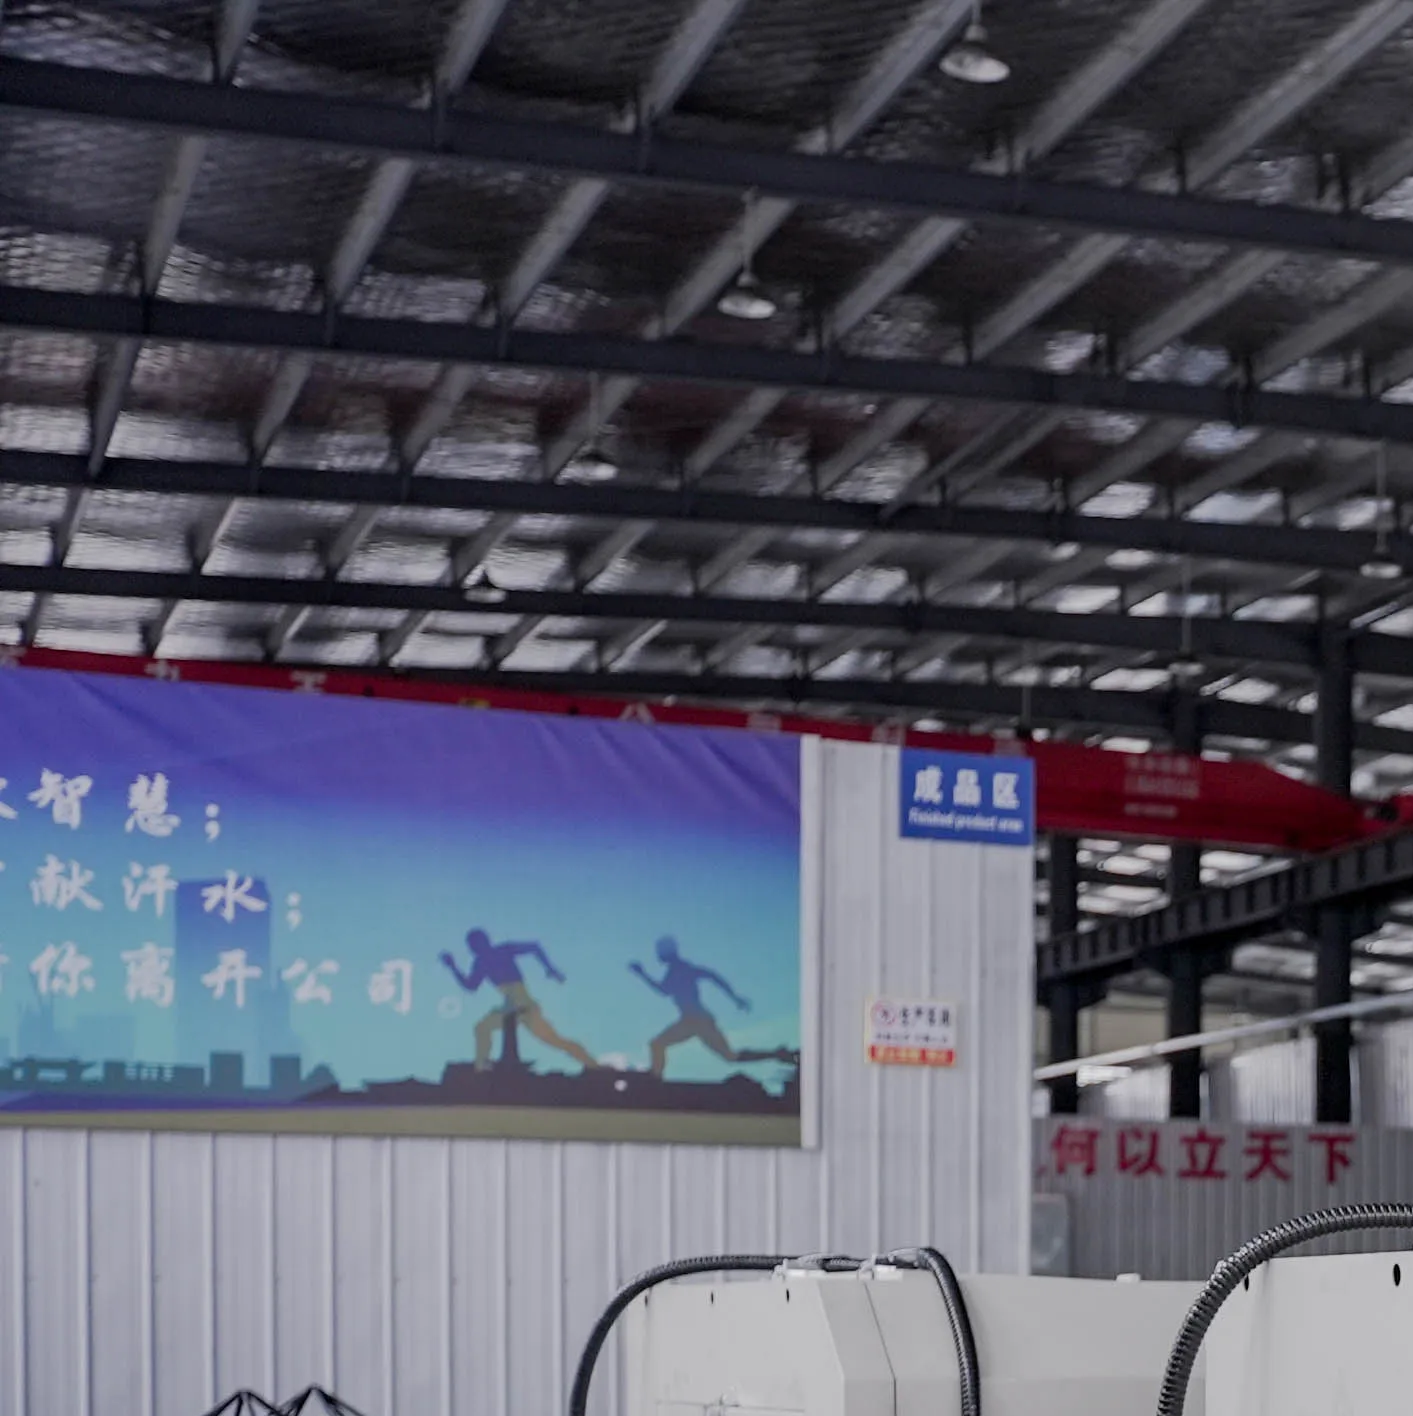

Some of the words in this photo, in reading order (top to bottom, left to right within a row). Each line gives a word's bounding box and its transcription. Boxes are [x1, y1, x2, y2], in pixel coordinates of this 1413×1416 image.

[0, 768, 220, 840] 智慧；
[913, 765, 1020, 809] 成品区
[0, 854, 302, 929] 献汗水；
[0, 941, 462, 1018] 你离开公司。
